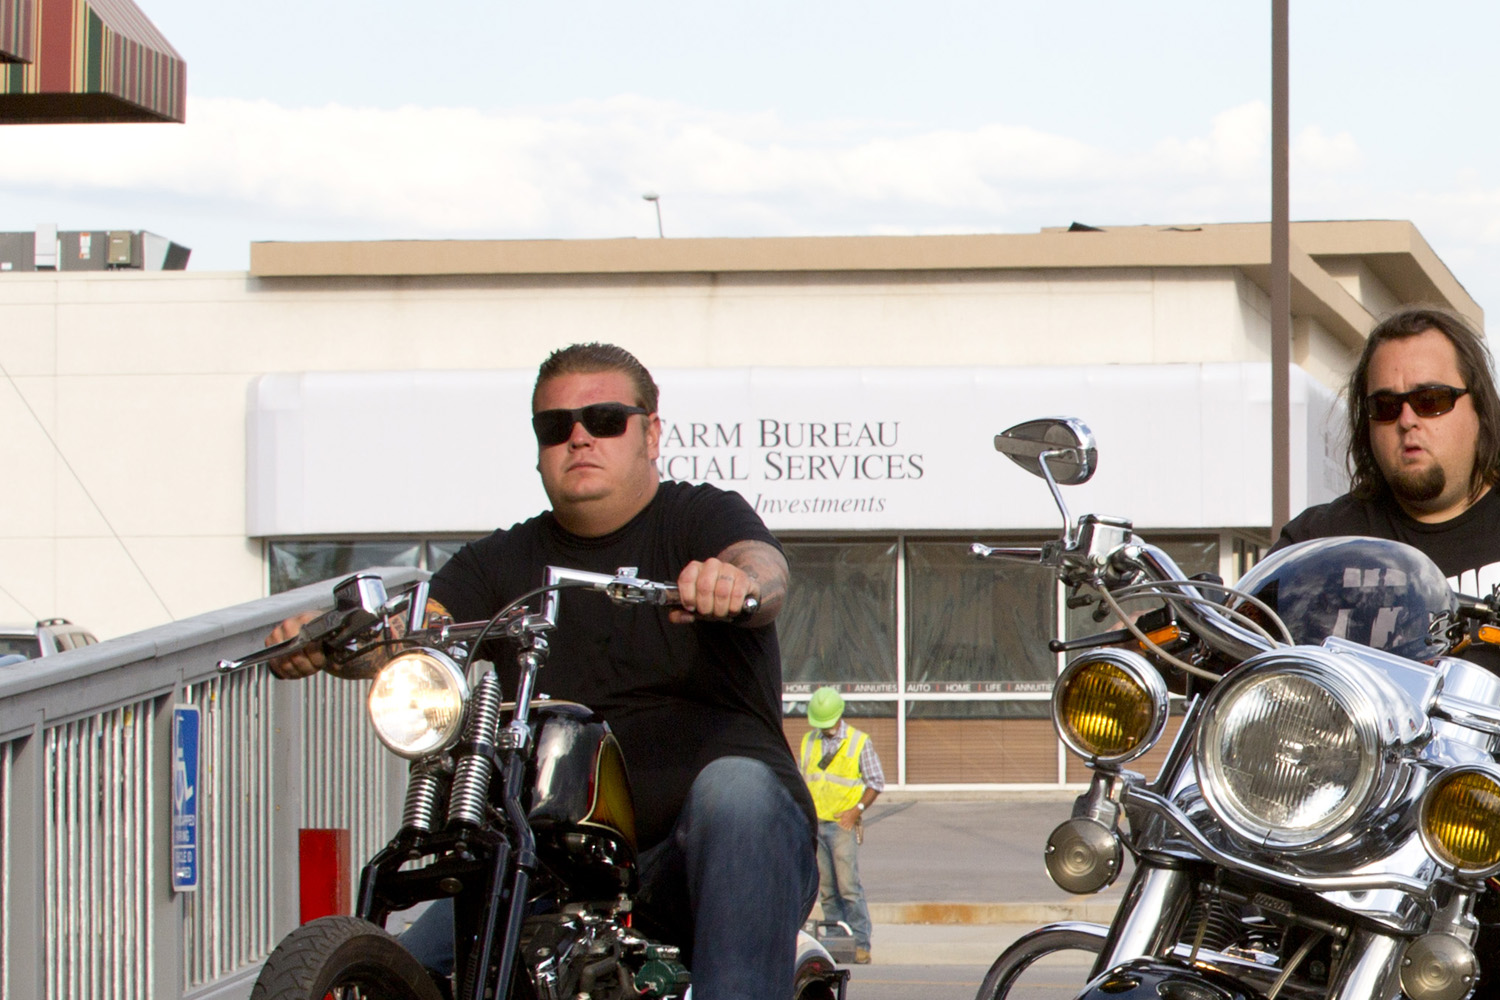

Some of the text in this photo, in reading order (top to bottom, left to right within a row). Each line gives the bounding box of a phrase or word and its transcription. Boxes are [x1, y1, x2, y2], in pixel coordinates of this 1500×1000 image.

[660, 418, 901, 448] ARM BUREAU
[764, 451, 925, 481] SERVICES
[754, 493, 887, 514] Investments
[785, 684, 811, 693] HOME
[854, 684, 898, 693] ANNUITIES
[907, 683, 931, 692] AUTO
[945, 683, 971, 692] HOME
[985, 683, 1002, 692] LIFE
